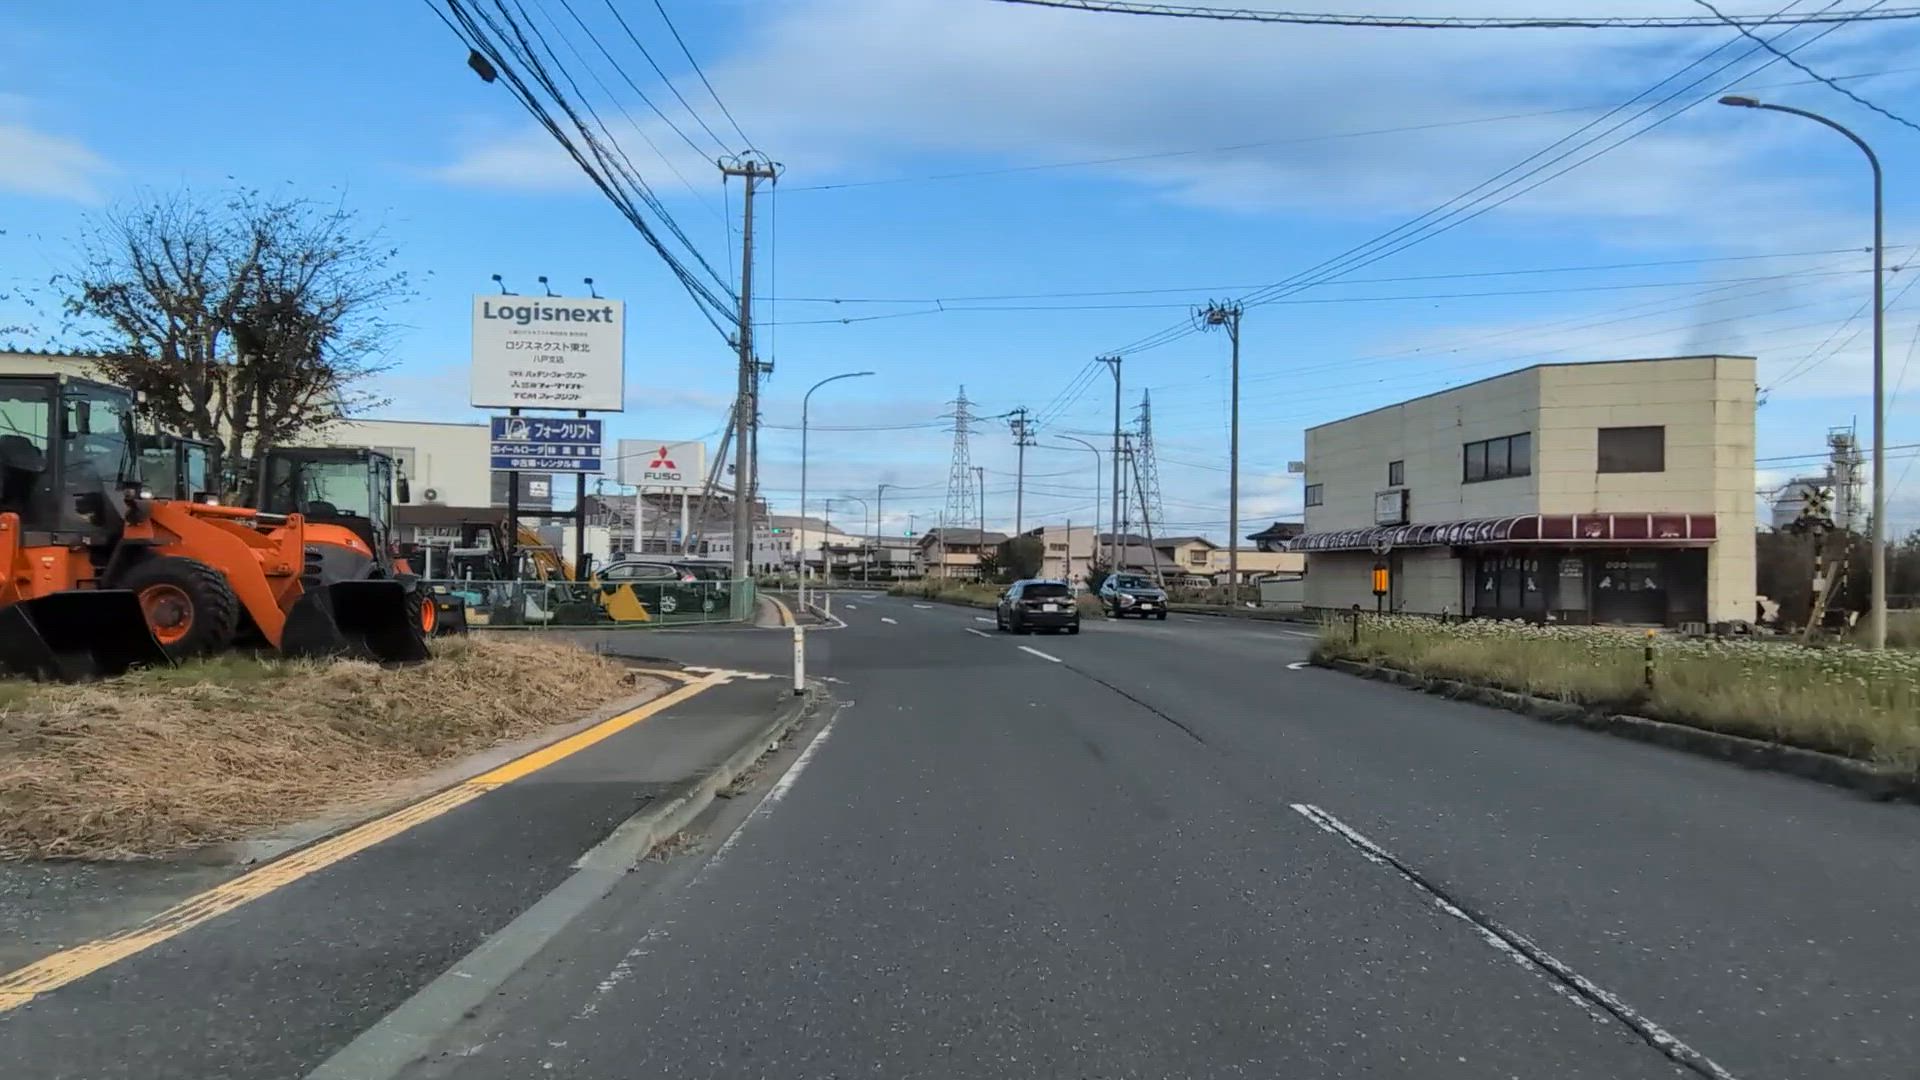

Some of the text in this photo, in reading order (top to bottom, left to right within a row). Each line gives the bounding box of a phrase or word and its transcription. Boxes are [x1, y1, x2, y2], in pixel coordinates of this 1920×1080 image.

[484, 302, 613, 325] Logisnext
[506, 341, 590, 353] ロジスネクスト東北
[534, 423, 594, 439] フォークリフト
[644, 472, 682, 481] FUSO
